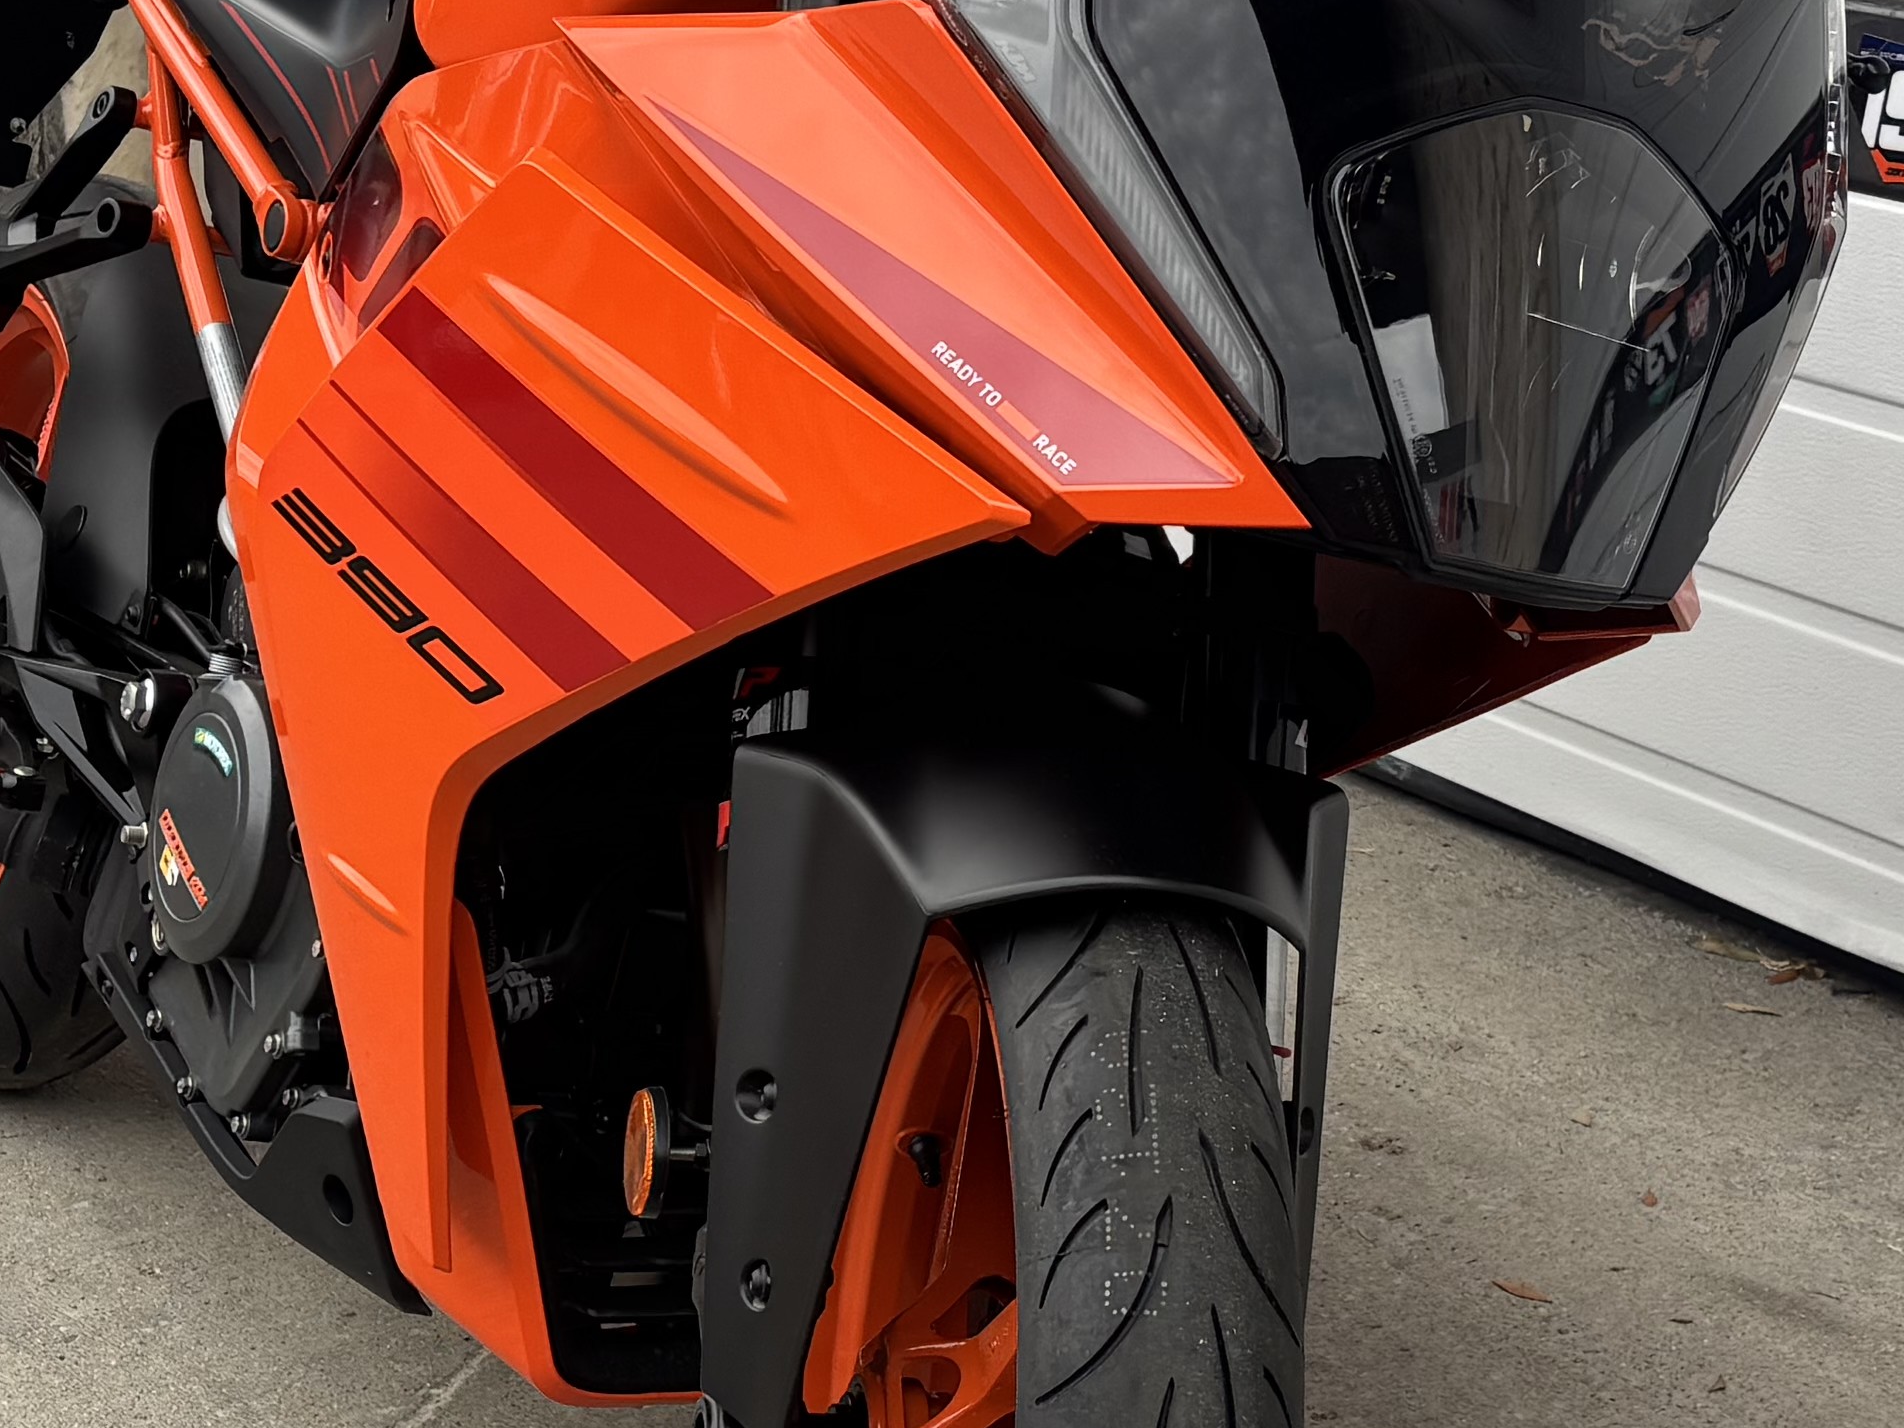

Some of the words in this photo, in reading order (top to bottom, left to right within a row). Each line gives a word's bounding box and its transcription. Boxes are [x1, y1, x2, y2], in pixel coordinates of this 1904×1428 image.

[930, 340, 984, 389] READY
[977, 381, 1003, 408] TO
[1032, 433, 1078, 476] RACE
[271, 487, 505, 705] 390
